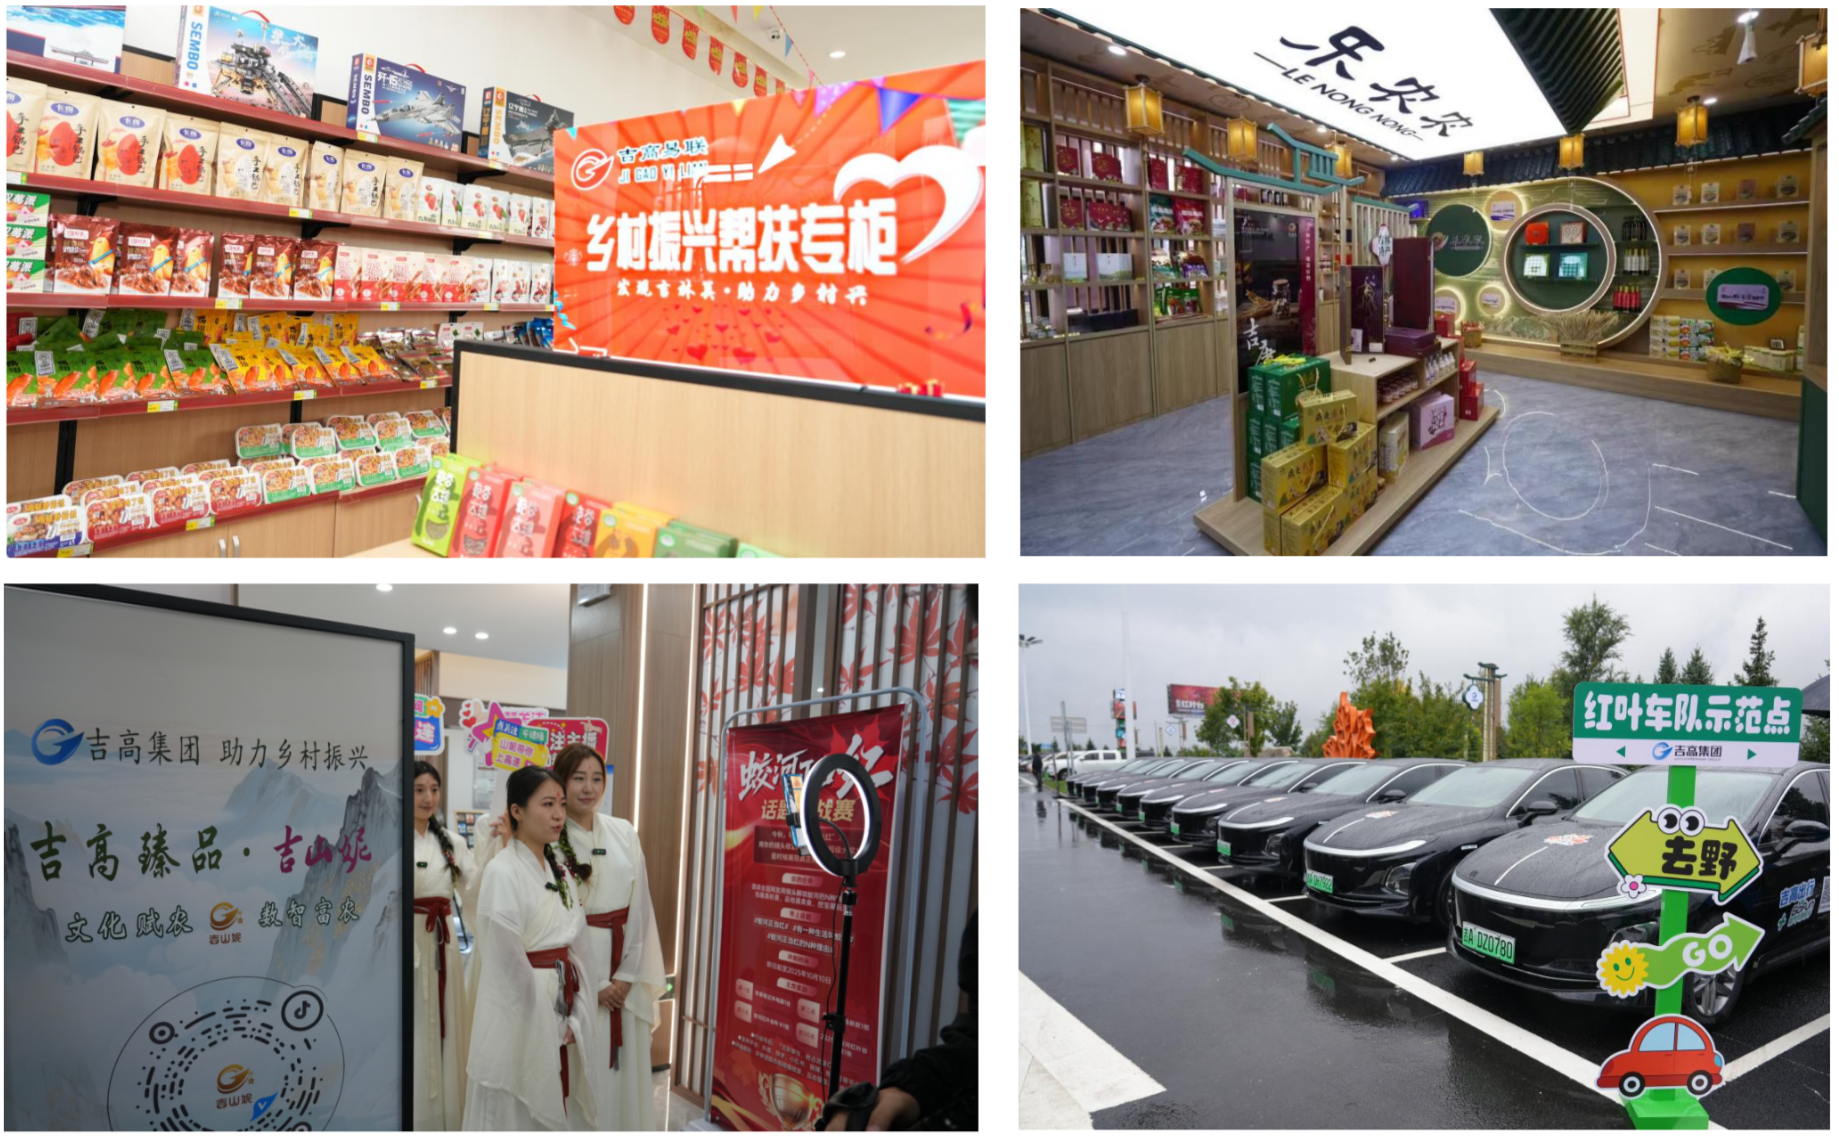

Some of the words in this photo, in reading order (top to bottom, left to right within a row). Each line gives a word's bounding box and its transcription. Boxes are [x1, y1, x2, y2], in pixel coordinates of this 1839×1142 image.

[187, 21, 203, 70] SEMBO
[361, 73, 373, 115] SEMBO
[1281, 67, 1316, 85] LE
[1310, 83, 1375, 116] NONG
[1370, 114, 1417, 137] NONG
[618, 138, 708, 163] 吉高易联
[619, 169, 630, 183] JI
[635, 167, 657, 182] GAO
[663, 164, 674, 178] YI
[586, 198, 898, 276] 乡村振兴帮扶专柜
[496, 719, 519, 737] 点关注
[1583, 689, 1792, 735] 红叶车队示范点
[85, 727, 201, 767] 吉高集团
[219, 736, 370, 773] 助力乡村振兴
[495, 751, 522, 768] 上高速
[499, 738, 534, 758] 山妮带你
[1674, 744, 1723, 758] 吉高集团
[1661, 835, 1739, 881] 去野
[1779, 877, 1816, 909] 吉高出行
[64, 905, 194, 943] 文化赋农
[258, 895, 361, 929] 数智富农
[208, 932, 242, 945] 吉山妮
[1477, 931, 1513, 960] DZ0780
[1682, 933, 1734, 967] GO
[215, 1093, 253, 1110] 吉山妮
